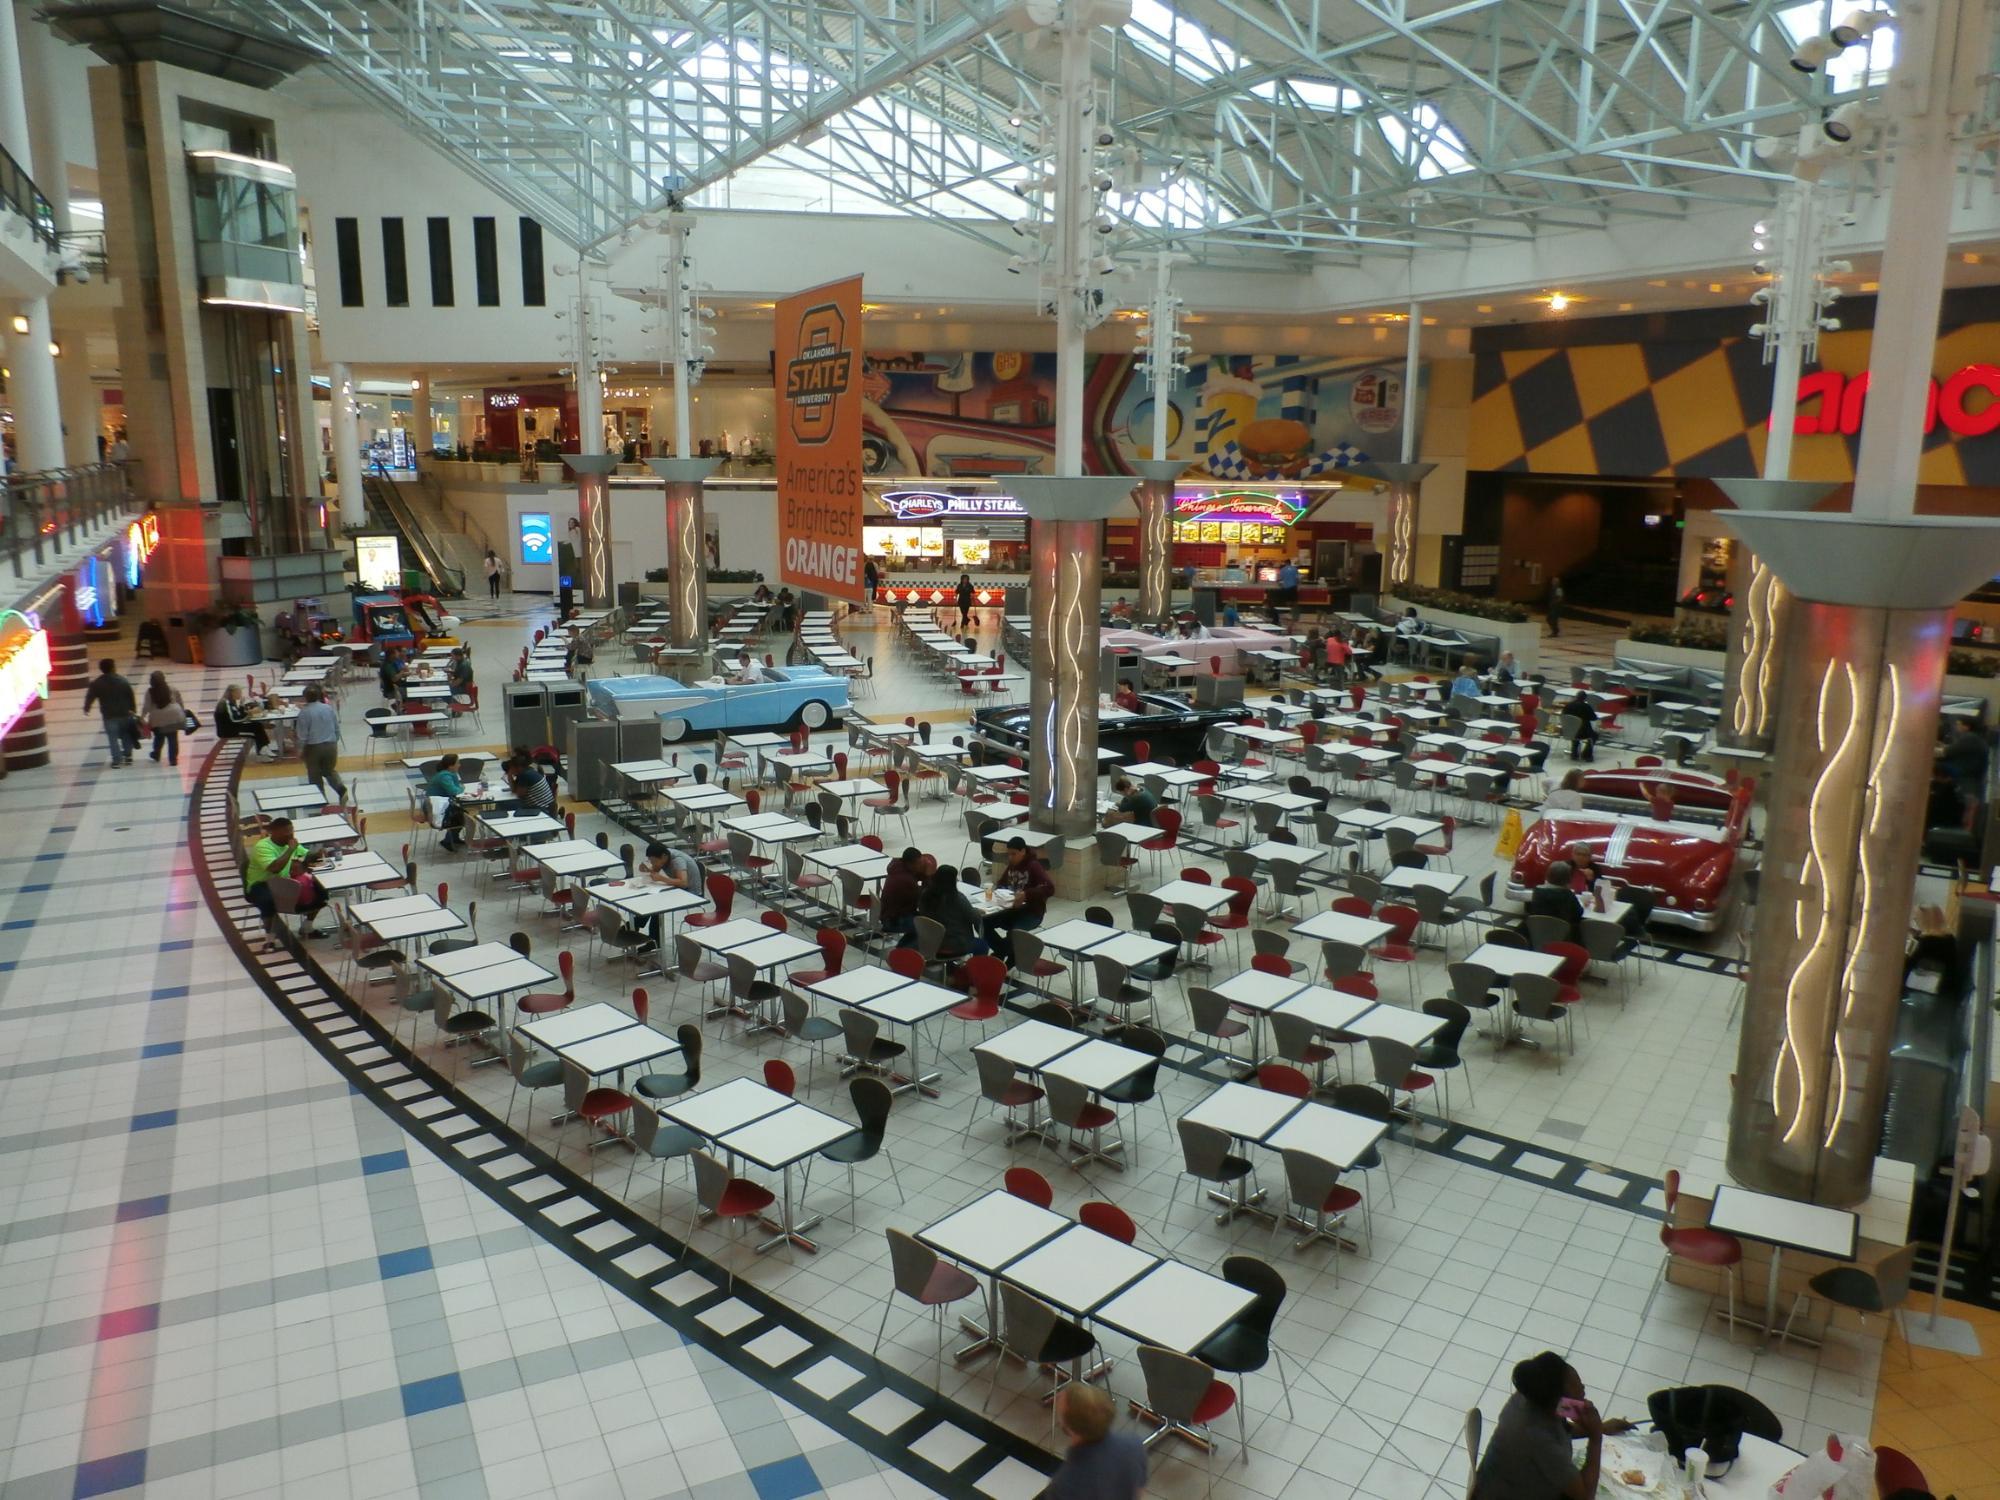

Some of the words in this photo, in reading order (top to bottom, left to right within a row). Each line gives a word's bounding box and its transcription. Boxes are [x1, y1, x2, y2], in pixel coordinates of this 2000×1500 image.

[803, 347, 835, 360] OKLAHOMA
[789, 358, 848, 391] STATE
[797, 393, 831, 405] UNIVERSITY
[786, 461, 856, 496] America's
[899, 499, 944, 511] CHARLEYS
[947, 500, 984, 511] PHILLY
[787, 498, 855, 539] Brightest
[786, 537, 858, 585] ORANGE
